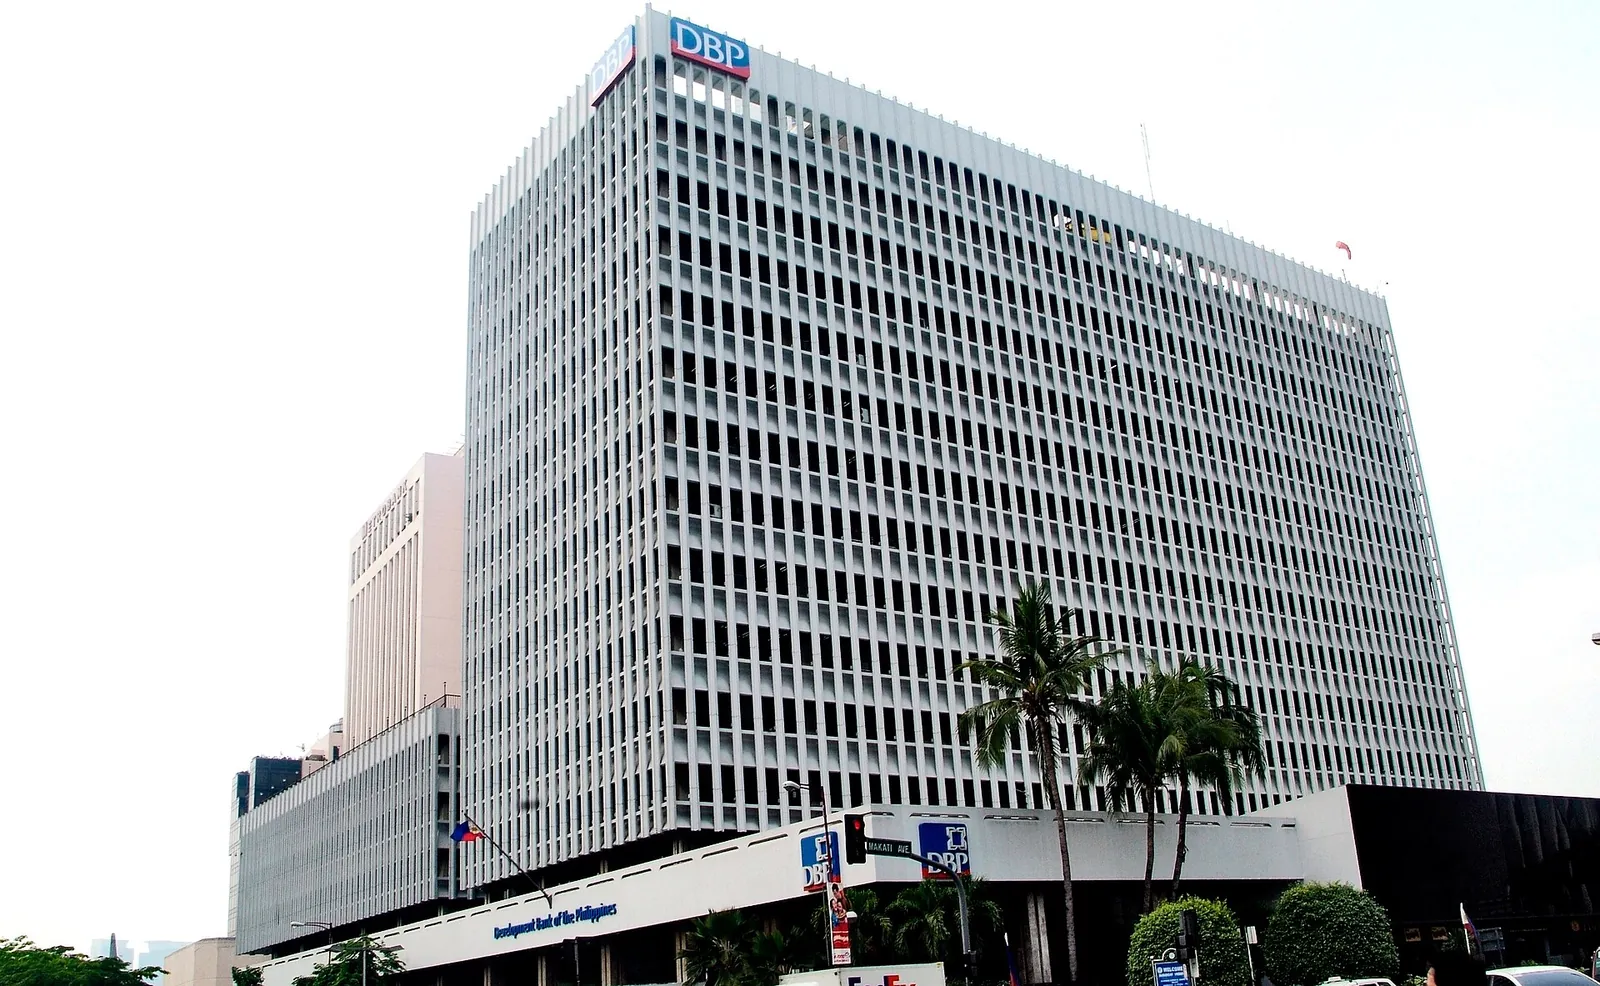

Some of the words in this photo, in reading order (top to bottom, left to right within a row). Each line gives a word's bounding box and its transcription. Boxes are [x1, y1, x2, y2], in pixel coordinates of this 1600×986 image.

[676, 22, 744, 69] DBP
[592, 34, 630, 94] DBP
[868, 842, 893, 853] MAKATI
[897, 844, 911, 854] AVE
[927, 852, 968, 874] DBP
[804, 861, 832, 886] DBP
[494, 919, 535, 939] Development
[536, 914, 553, 931] Bank
[554, 911, 563, 926] of
[563, 910, 575, 924] the
[576, 903, 617, 923] Philippines
